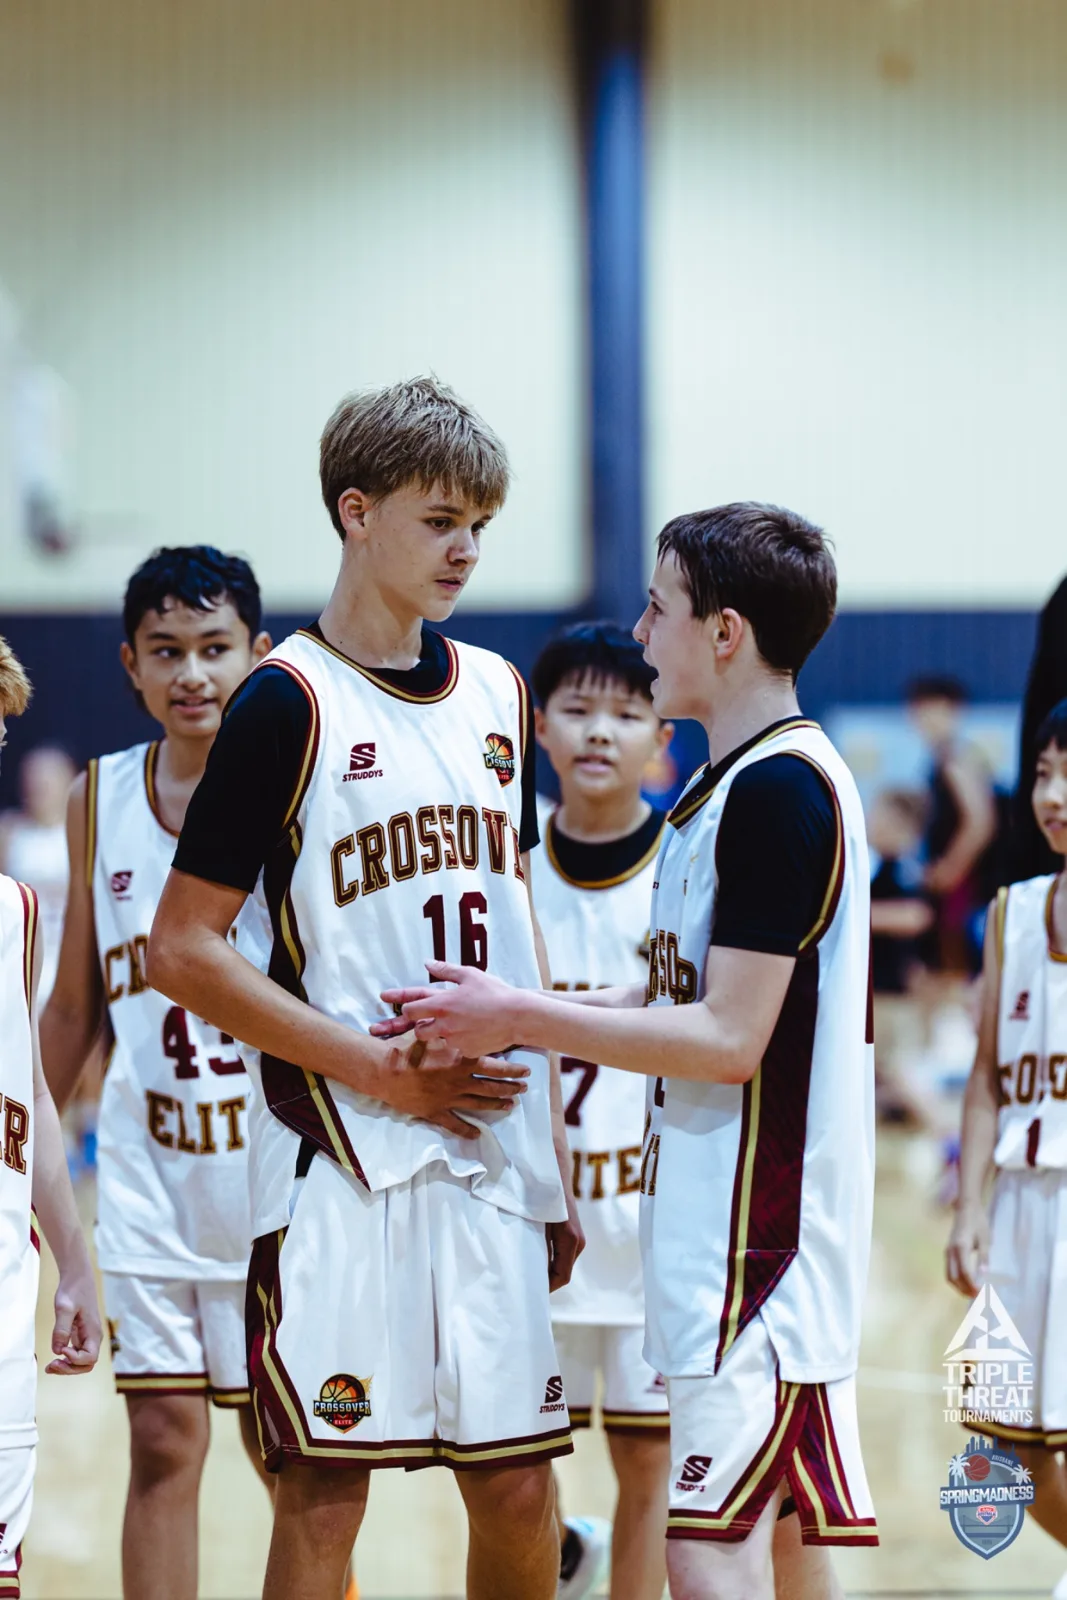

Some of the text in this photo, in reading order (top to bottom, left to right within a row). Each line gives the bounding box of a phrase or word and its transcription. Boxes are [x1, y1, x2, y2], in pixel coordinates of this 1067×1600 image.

[342, 769, 384, 782] STRUDDYS
[422, 891, 488, 980] 16
[560, 1056, 598, 1127] 7
[0, 1092, 30, 1175] R
[314, 1401, 371, 1415] CROSSOVER
